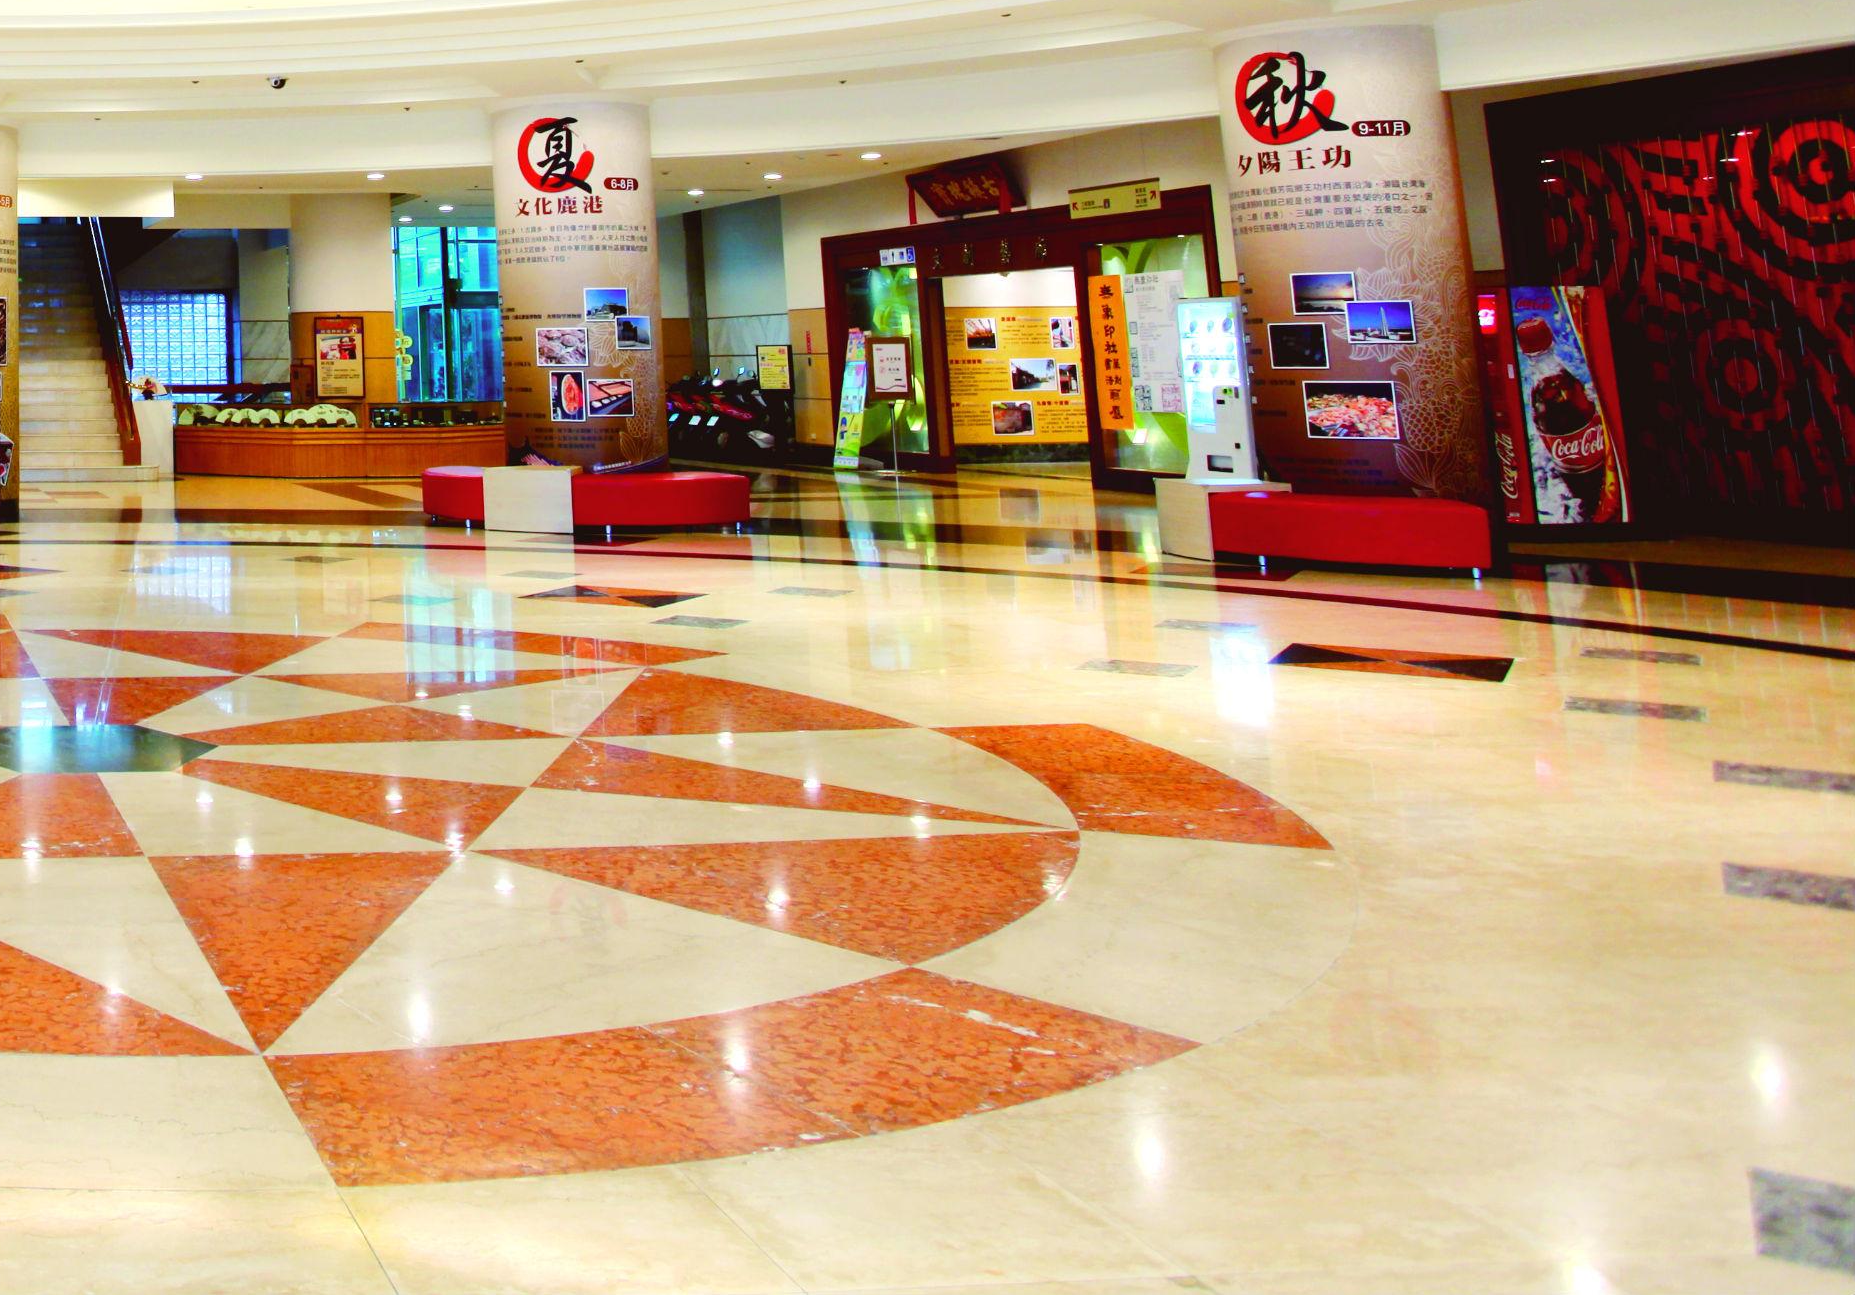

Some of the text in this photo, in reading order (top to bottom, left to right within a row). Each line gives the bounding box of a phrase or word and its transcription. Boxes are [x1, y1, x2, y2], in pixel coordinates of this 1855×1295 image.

[1244, 51, 1349, 139] 秋
[1358, 121, 1406, 137] 9-11月
[534, 117, 592, 194] 夏
[1238, 145, 1352, 177] 夕陽王功
[610, 179, 635, 191] 6-8月
[514, 195, 604, 218] 文化鹿港
